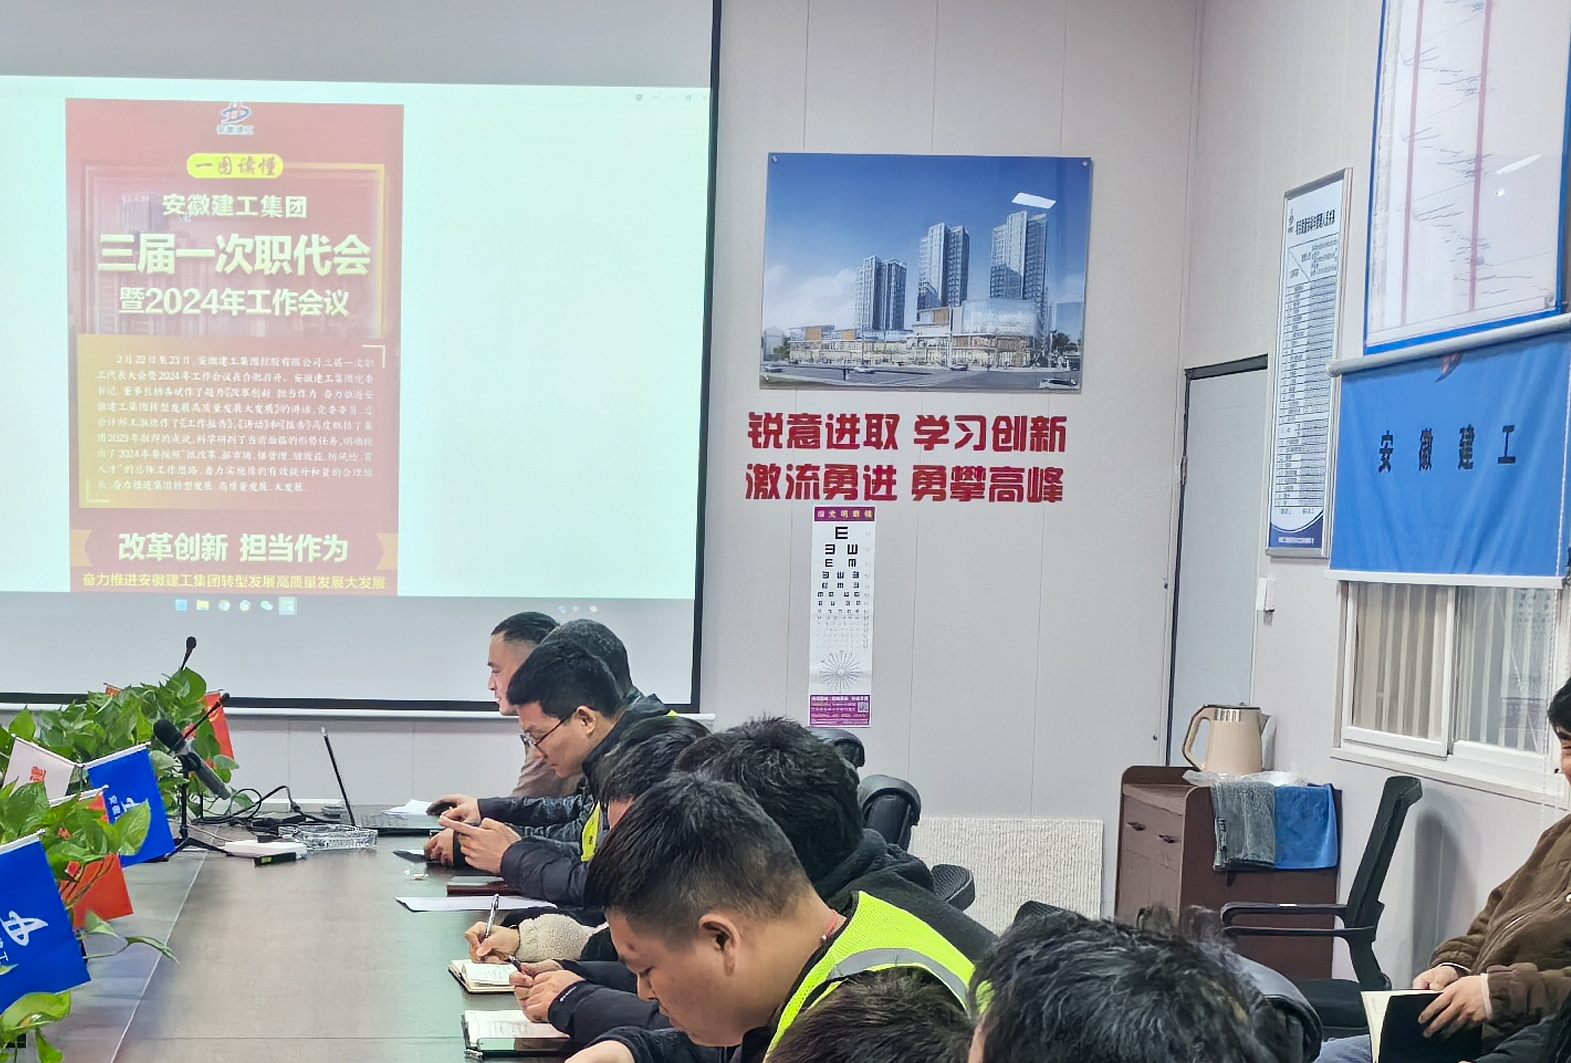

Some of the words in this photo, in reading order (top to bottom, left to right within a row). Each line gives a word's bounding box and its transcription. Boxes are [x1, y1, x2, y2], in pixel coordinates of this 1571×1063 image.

[195, 155, 278, 176] 一图读懂
[162, 193, 308, 218] 安徽建工集团
[97, 233, 372, 276] 三届一次职代会
[118, 286, 351, 317] 暨2024年工作会议
[747, 411, 900, 450] 锐意进取
[913, 414, 1068, 453] 学习创新
[1378, 423, 1517, 473] 安徽建工
[745, 463, 898, 501] 激流勇进
[911, 465, 1064, 503] 勇攀高峰
[118, 532, 229, 562] 改革创新
[239, 532, 349, 563] 担当作为
[82, 572, 387, 591] 奋力推进安徽建工集团转型发展高质量发展大发展
